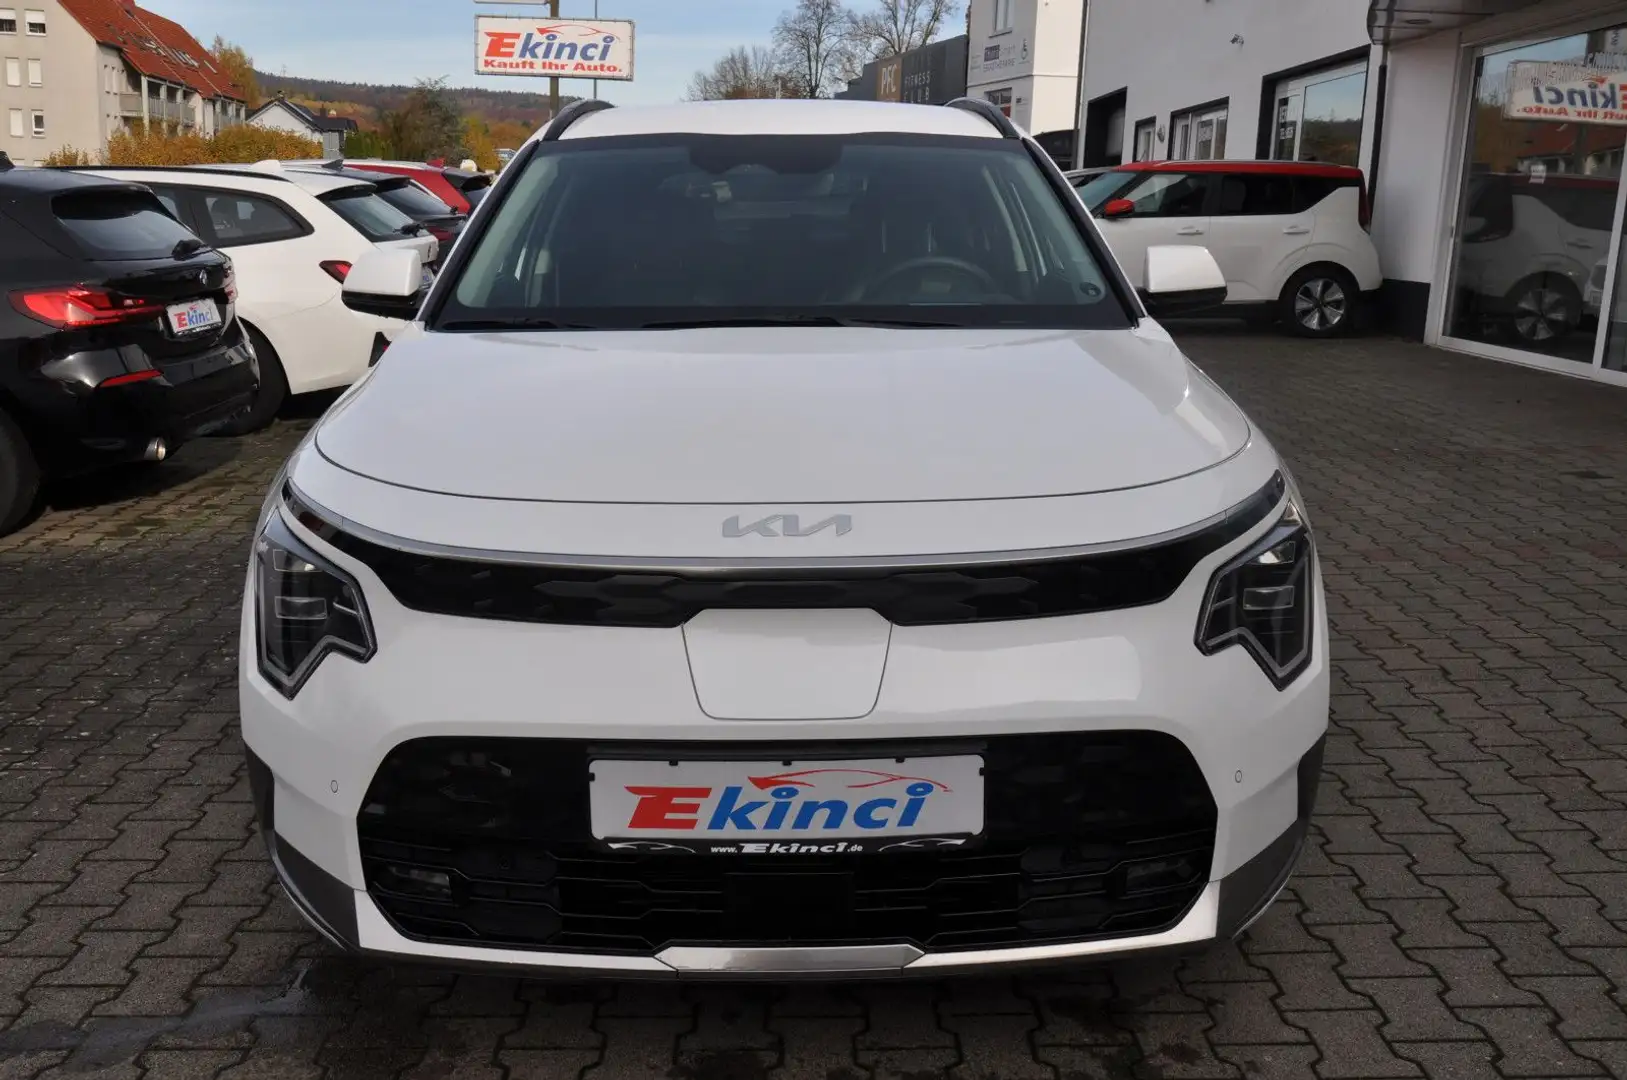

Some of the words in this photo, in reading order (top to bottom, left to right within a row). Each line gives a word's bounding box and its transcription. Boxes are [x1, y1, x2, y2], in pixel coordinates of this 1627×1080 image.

[484, 32, 615, 61] Ekinci
[484, 59, 536, 70] Kauft
[542, 61, 568, 71] Ihr
[573, 62, 623, 73] Auto.
[904, 71, 931, 87] FITNESS
[173, 309, 213, 328] Ekinci
[722, 513, 852, 538] KIA
[624, 782, 935, 831] Ekinci
[710, 841, 864, 854] www.Ekinci.de
